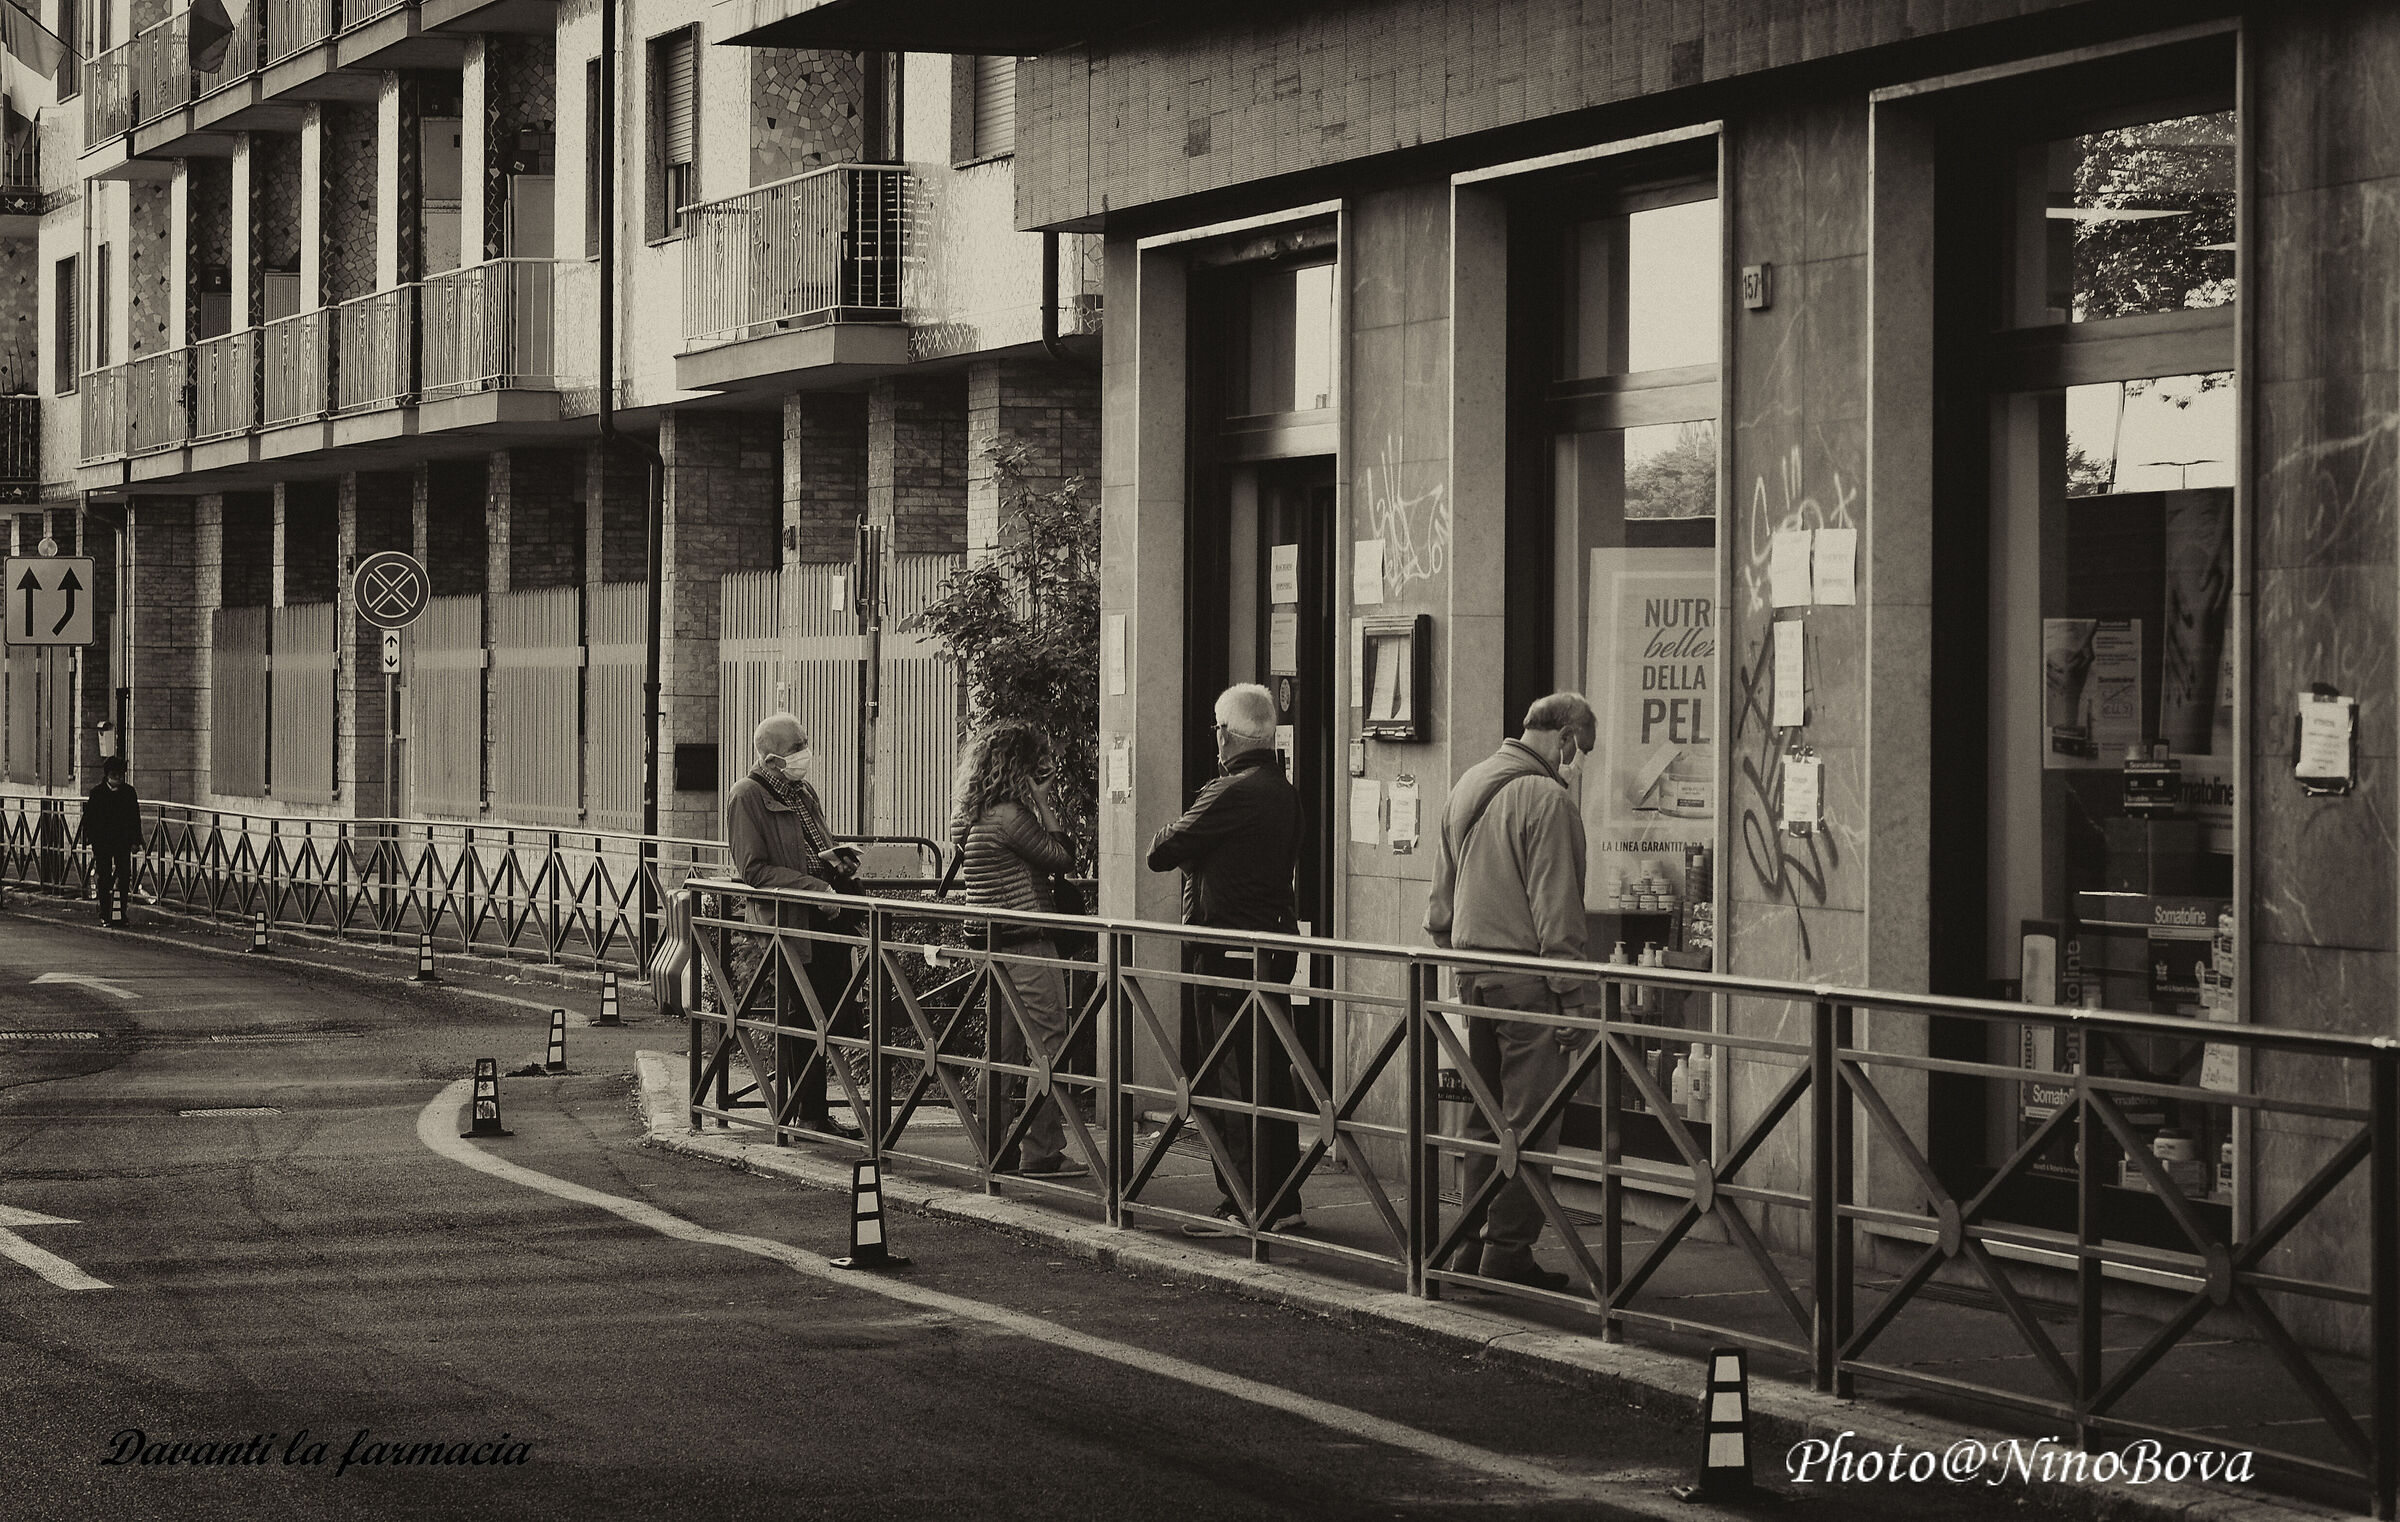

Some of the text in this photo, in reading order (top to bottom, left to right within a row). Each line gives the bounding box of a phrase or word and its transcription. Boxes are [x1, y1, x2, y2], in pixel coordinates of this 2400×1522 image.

[1744, 273, 1759, 299] 157
[1642, 665, 1707, 690] DELLA
[1641, 698, 1711, 744] PEL
[1602, 841, 1612, 852] LA
[1615, 841, 1639, 852] LINEA
[1641, 841, 1688, 852] GARANTITA
[2155, 905, 2206, 925] Somatoline
